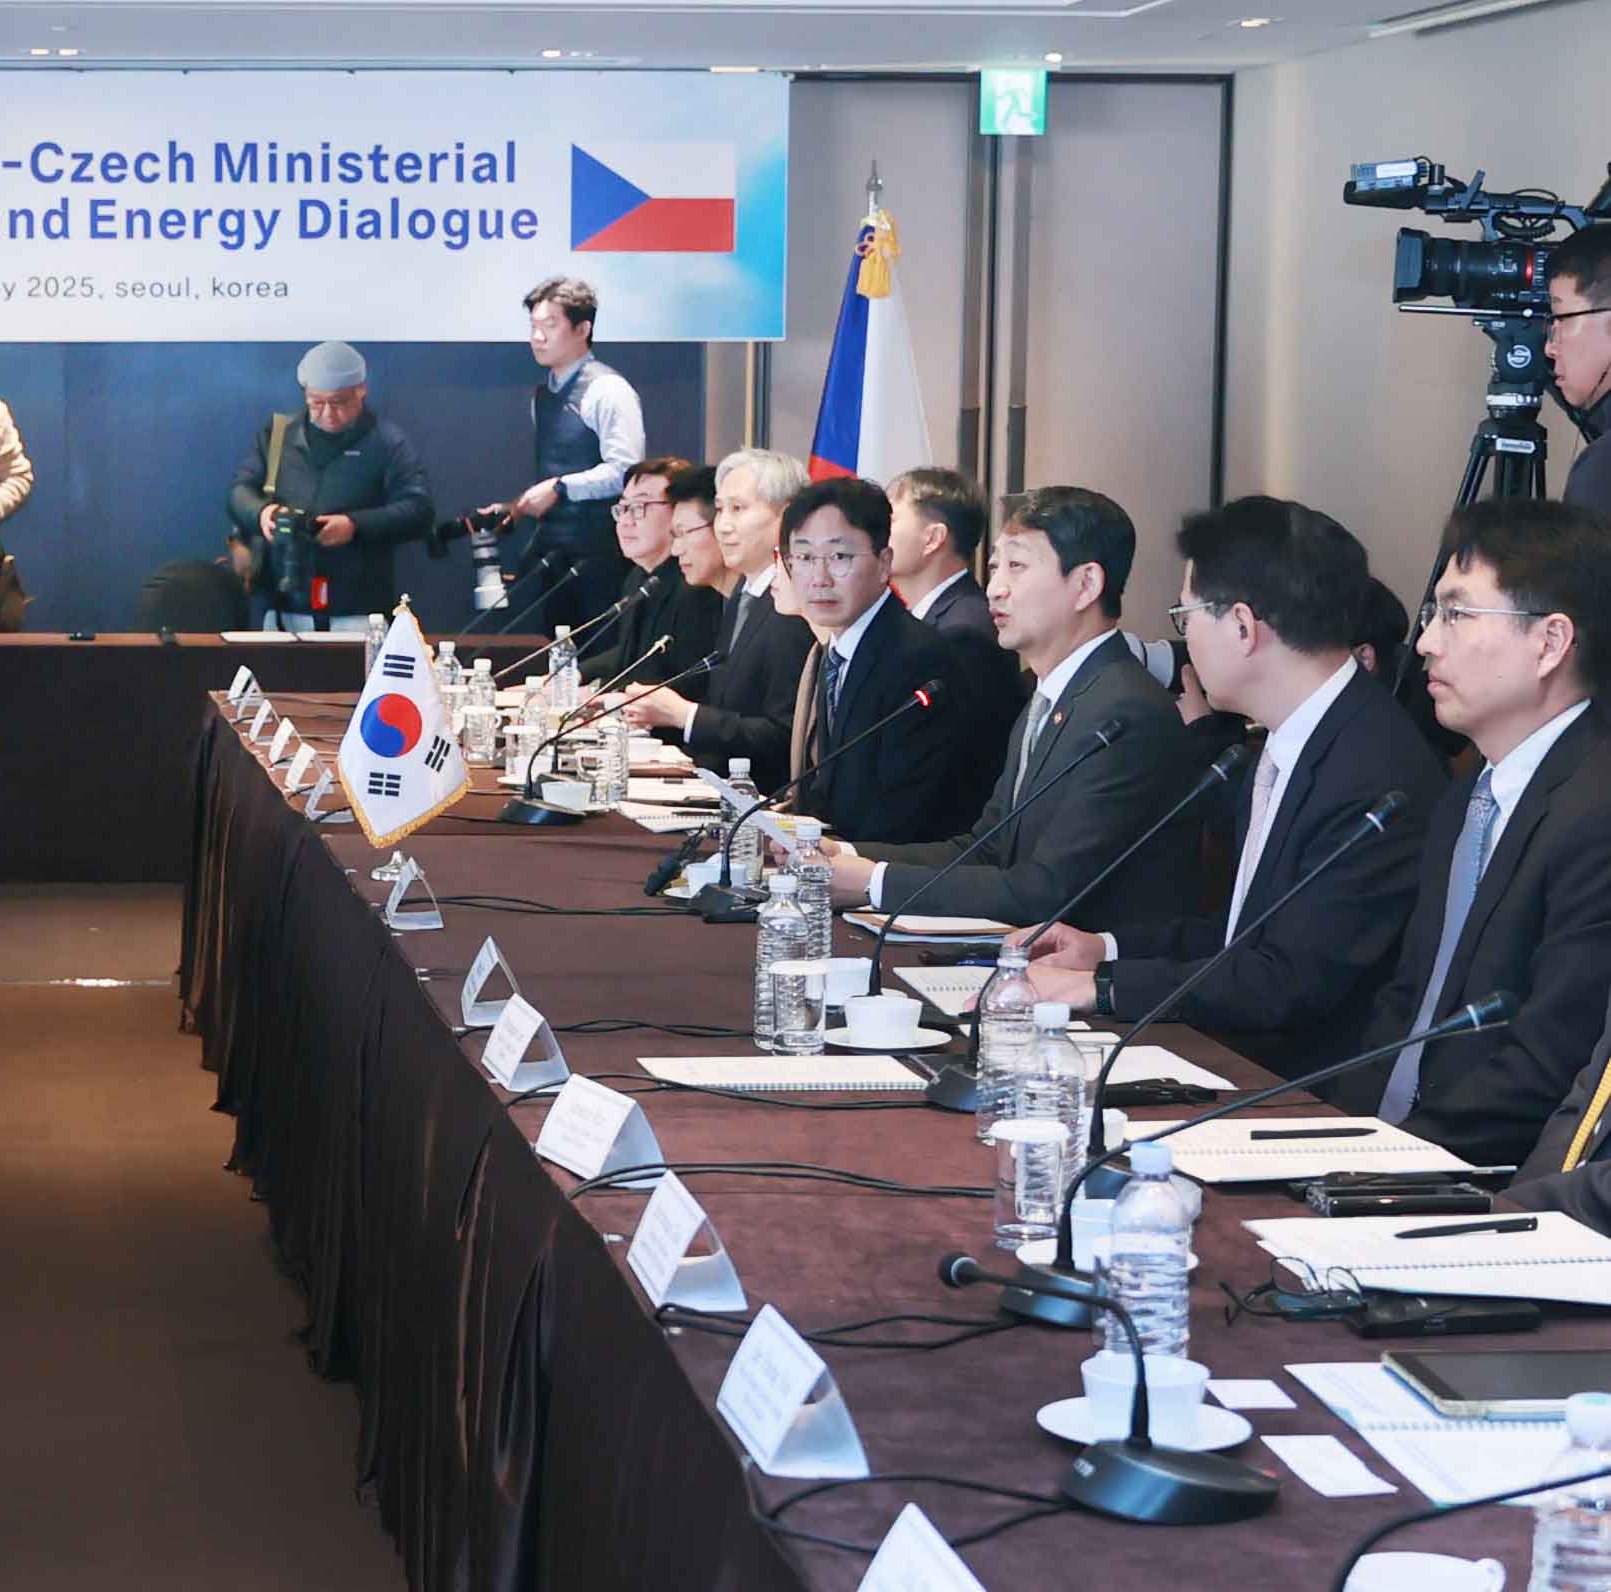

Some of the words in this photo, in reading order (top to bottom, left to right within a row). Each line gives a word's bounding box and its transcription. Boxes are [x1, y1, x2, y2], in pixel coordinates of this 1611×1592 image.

[214, 141, 515, 183] Ministerial
[90, 199, 281, 250] Energy
[299, 197, 538, 250] Dialogue
[28, 276, 102, 299] 2025,
[116, 277, 198, 300] seoul,
[212, 277, 288, 297] korea
